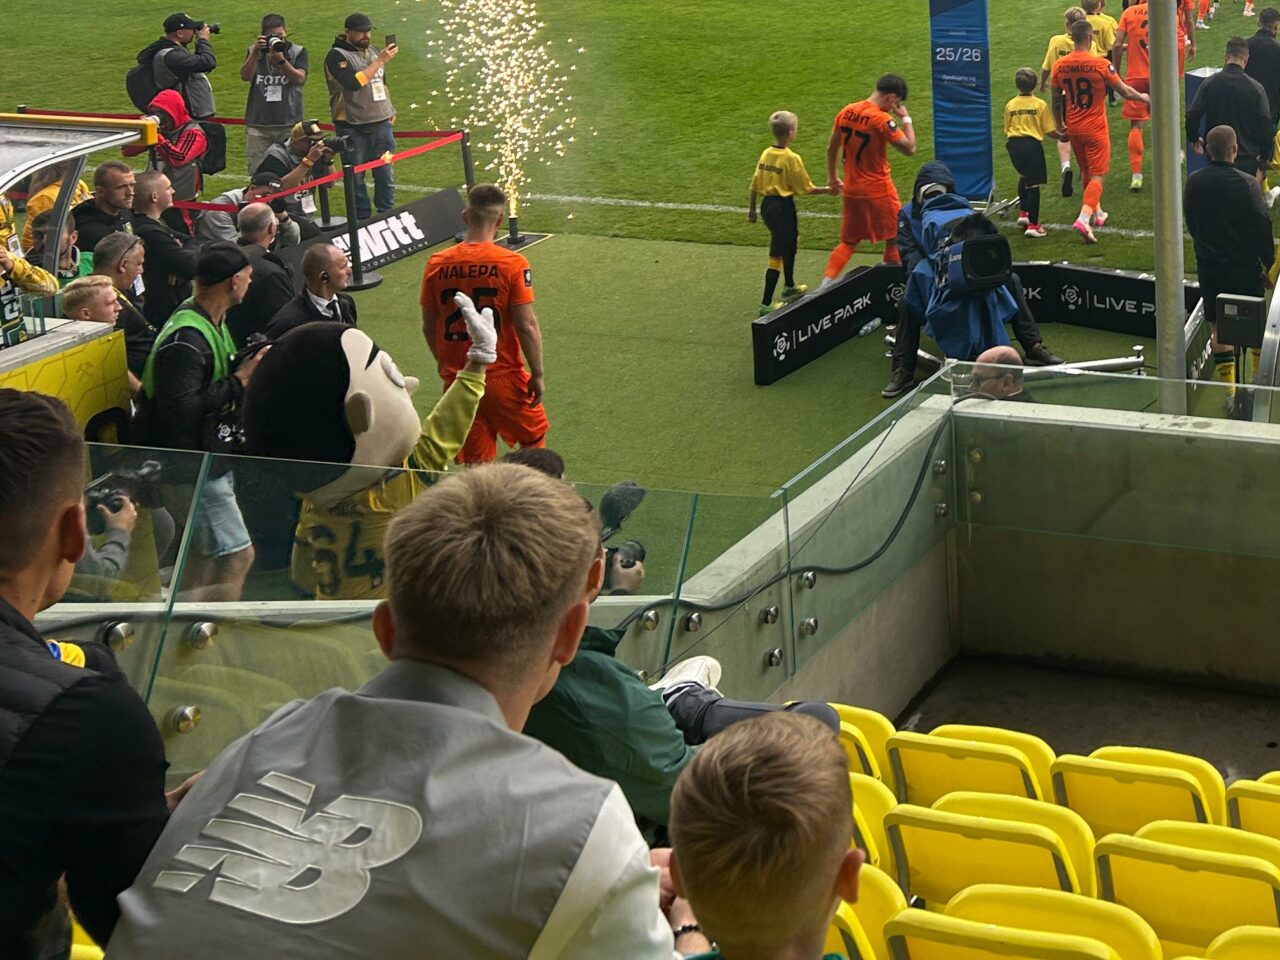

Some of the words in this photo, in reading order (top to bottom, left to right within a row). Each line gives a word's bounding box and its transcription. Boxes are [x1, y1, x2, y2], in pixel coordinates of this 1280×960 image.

[936, 47, 981, 61] 25/26
[255, 74, 289, 86] FOTO
[1063, 76, 1094, 109] 18
[843, 110, 870, 126] SZMYT
[840, 125, 871, 166] 77
[438, 265, 499, 281] NALEPA
[1093, 294, 1138, 314] LIVE
[441, 287, 499, 342] 25
[798, 314, 832, 343] LIVE
[834, 292, 872, 324] PARK
